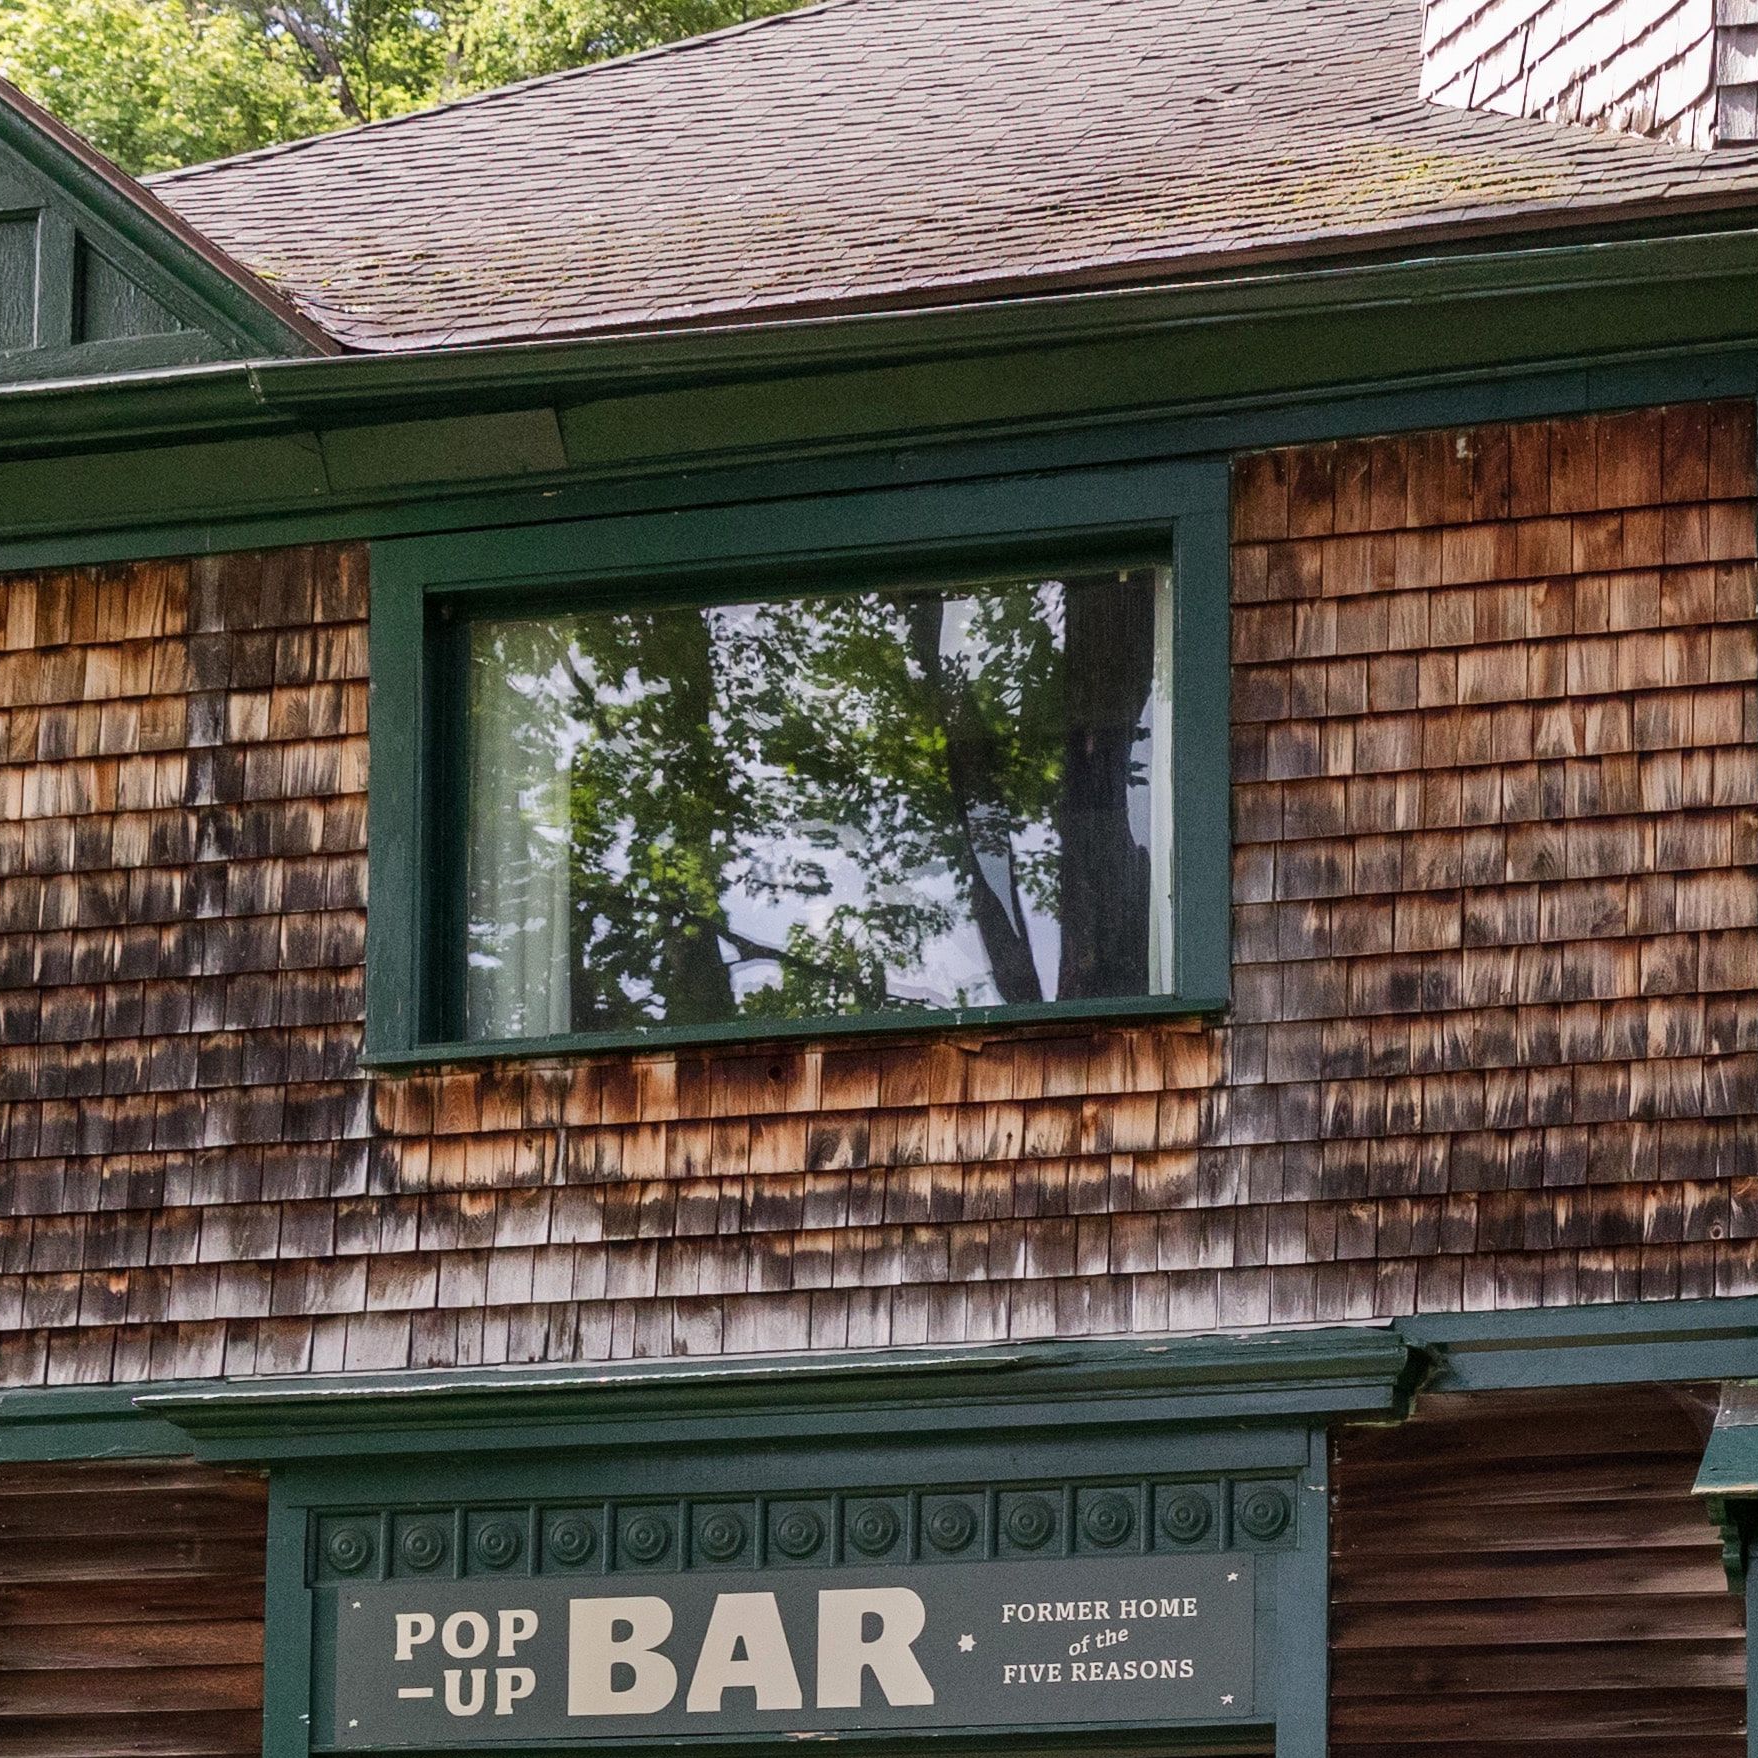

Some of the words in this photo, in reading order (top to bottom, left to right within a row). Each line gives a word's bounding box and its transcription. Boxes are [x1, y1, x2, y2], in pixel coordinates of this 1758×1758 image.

[1001, 1601, 1111, 1624] FORMER
[1119, 1597, 1198, 1620] HOME
[394, 1609, 539, 1661] POP
[1068, 1634, 1091, 1657] of
[1095, 1628, 1130, 1649] the
[567, 1586, 935, 1717] BAR
[1002, 1662, 1063, 1685] FIVE
[1070, 1658, 1195, 1683] REASONS
